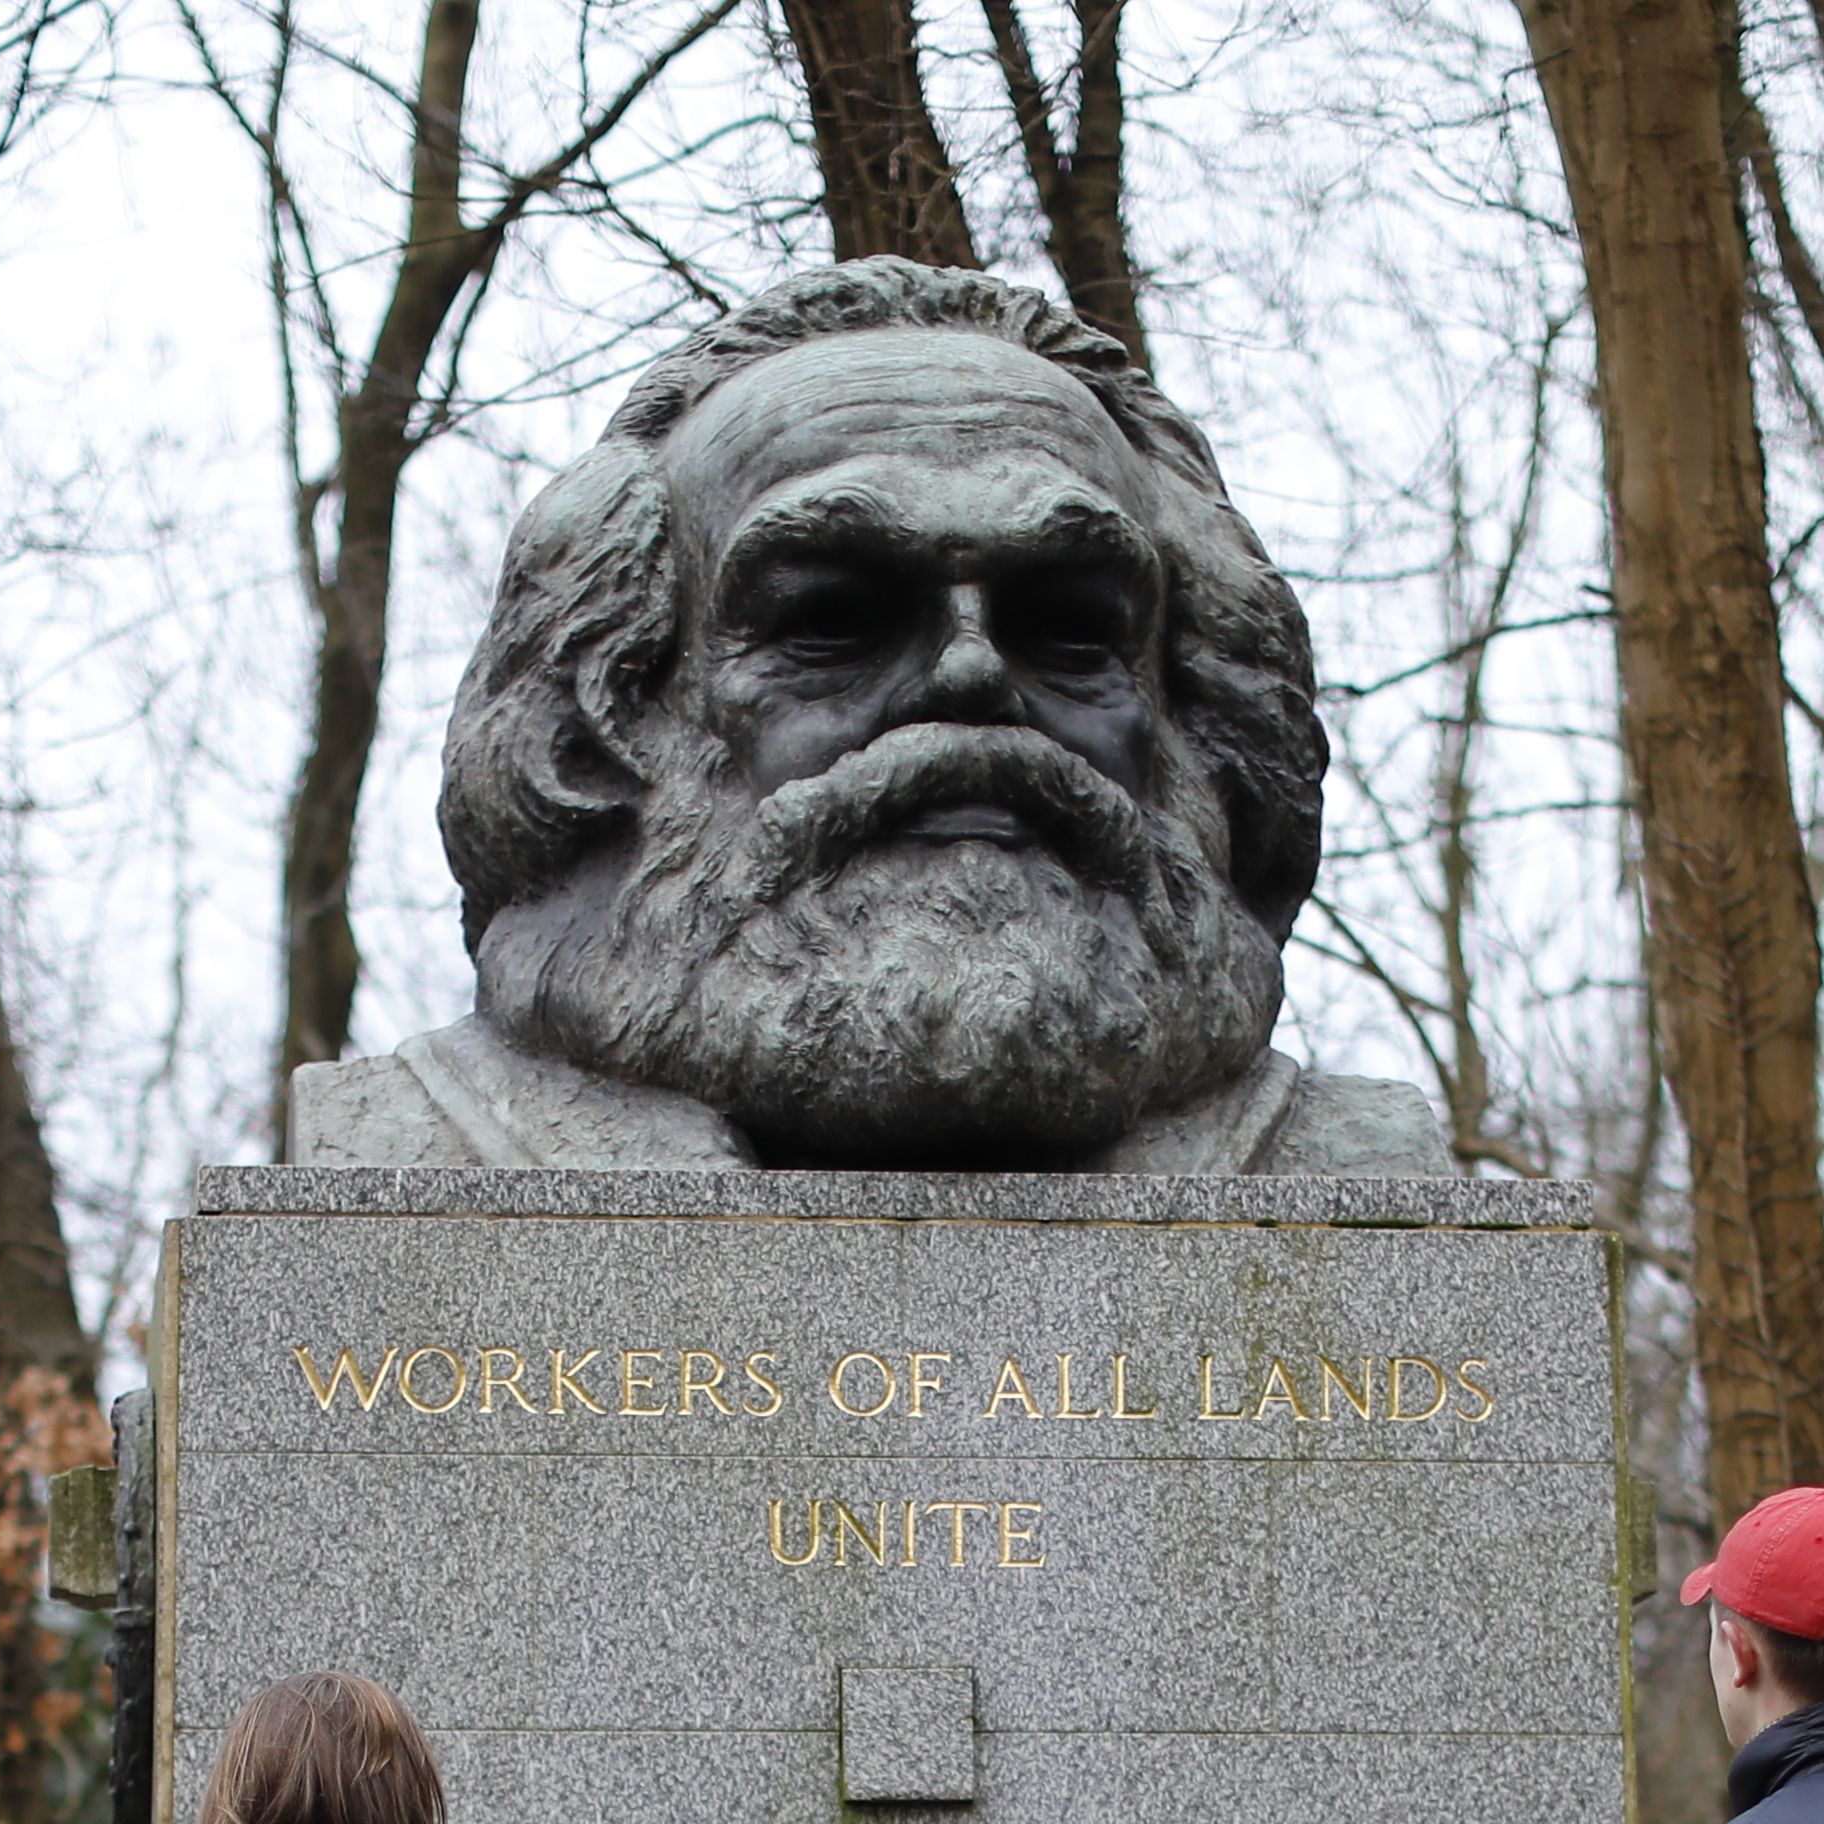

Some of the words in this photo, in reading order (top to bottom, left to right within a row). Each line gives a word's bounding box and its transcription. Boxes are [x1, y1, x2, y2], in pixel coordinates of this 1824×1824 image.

[295, 1345, 782, 1417] WORKERS
[827, 1352, 953, 1418] OF
[984, 1356, 1157, 1421] ALL
[1197, 1354, 1495, 1424] LANDS
[768, 1498, 1046, 1567] UNITE
